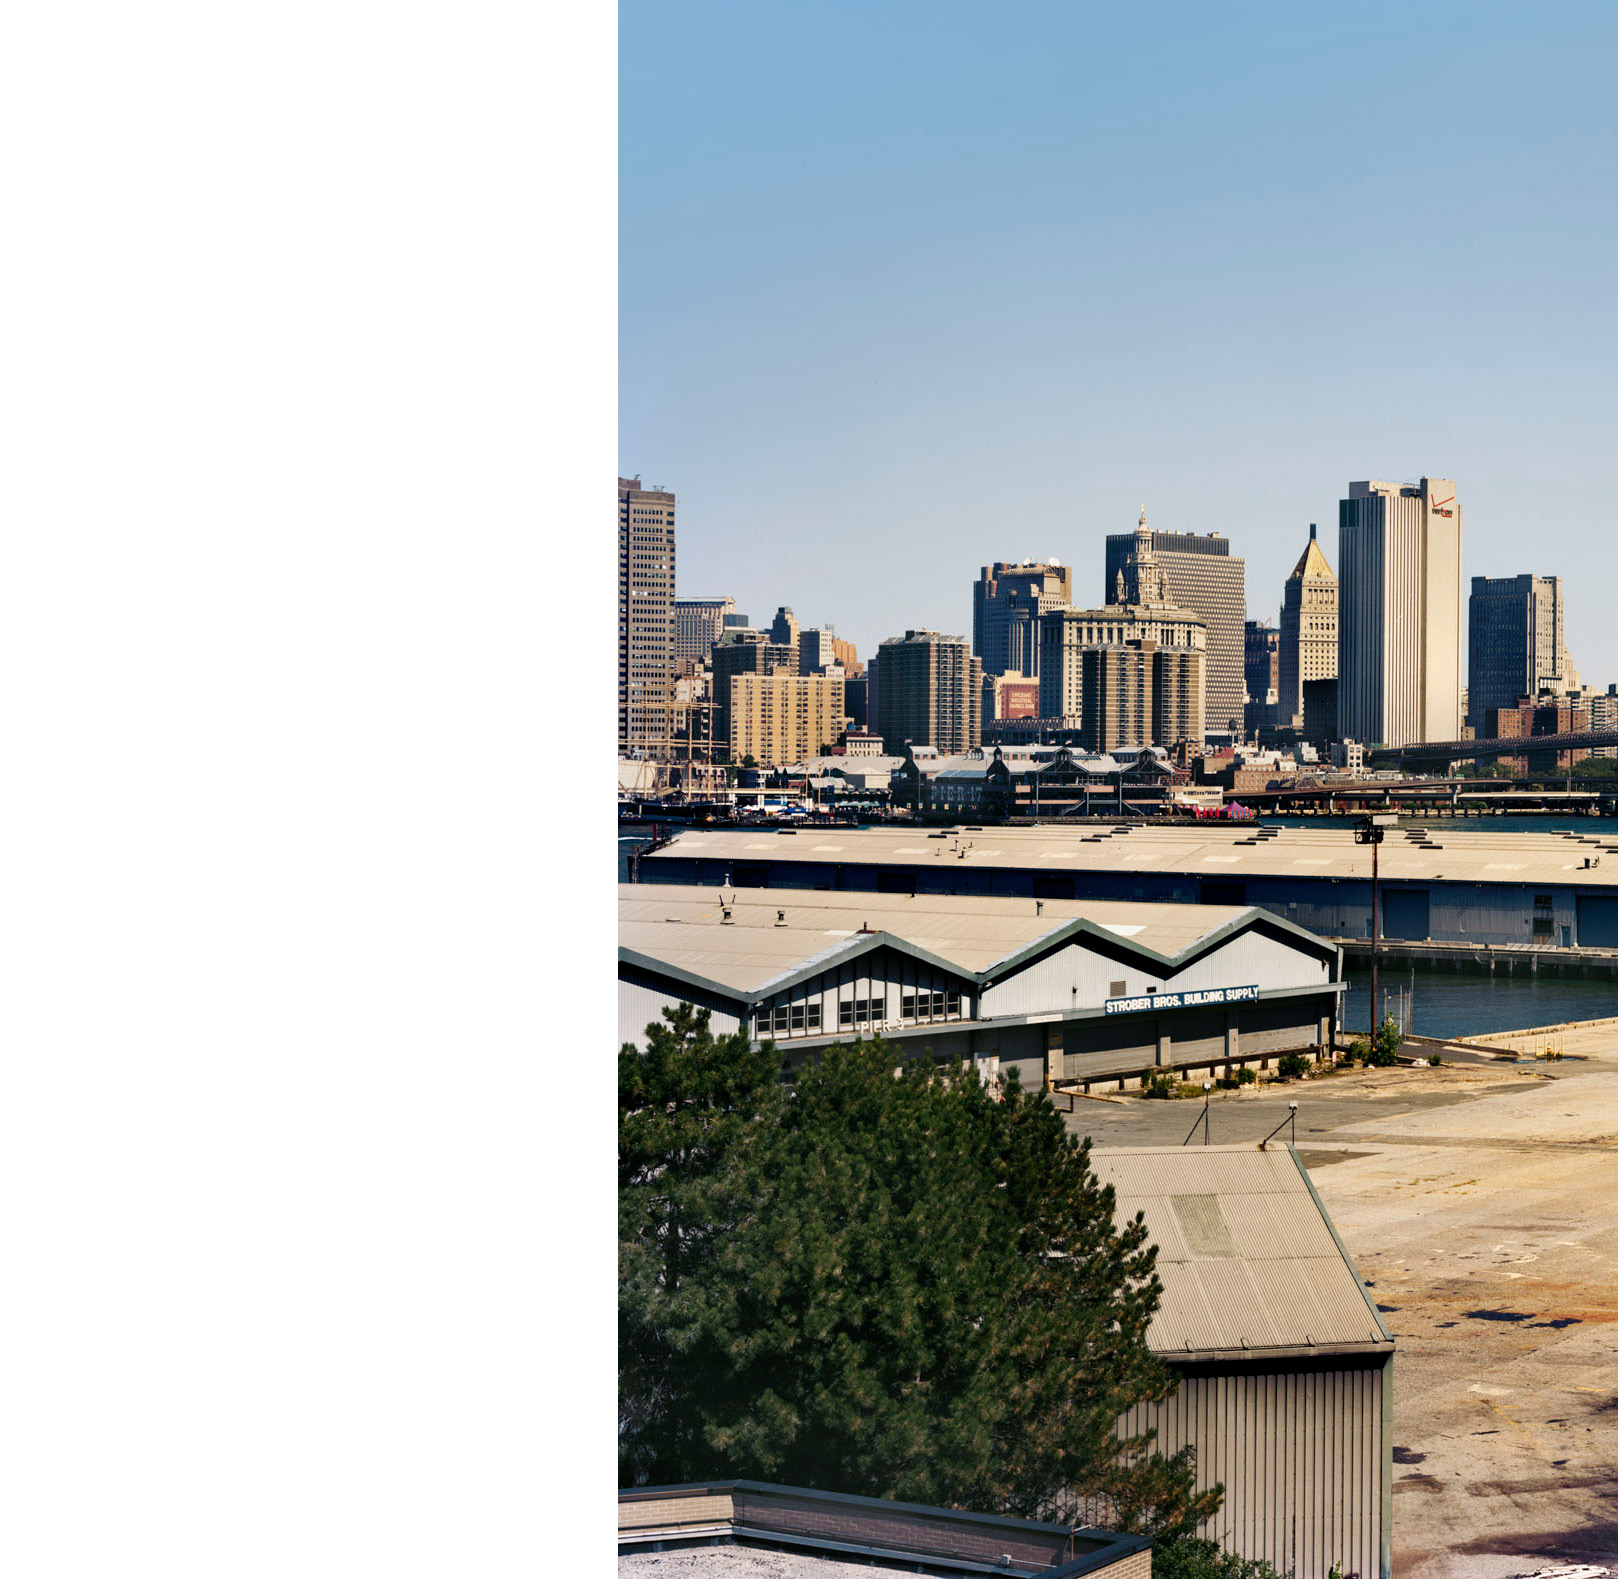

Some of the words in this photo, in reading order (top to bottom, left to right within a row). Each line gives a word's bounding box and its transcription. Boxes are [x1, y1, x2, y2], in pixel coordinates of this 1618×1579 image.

[1431, 507, 1453, 518] verizon
[931, 785, 964, 801] PIER
[971, 786, 983, 801] 17
[1106, 997, 1151, 1014] STROBER
[1153, 994, 1182, 1009] BROS.
[1184, 990, 1224, 1005] BUILDING
[1225, 986, 1259, 1001] SUPPLY
[861, 1019, 892, 1034] PIER
[896, 1018, 904, 1030] 3
